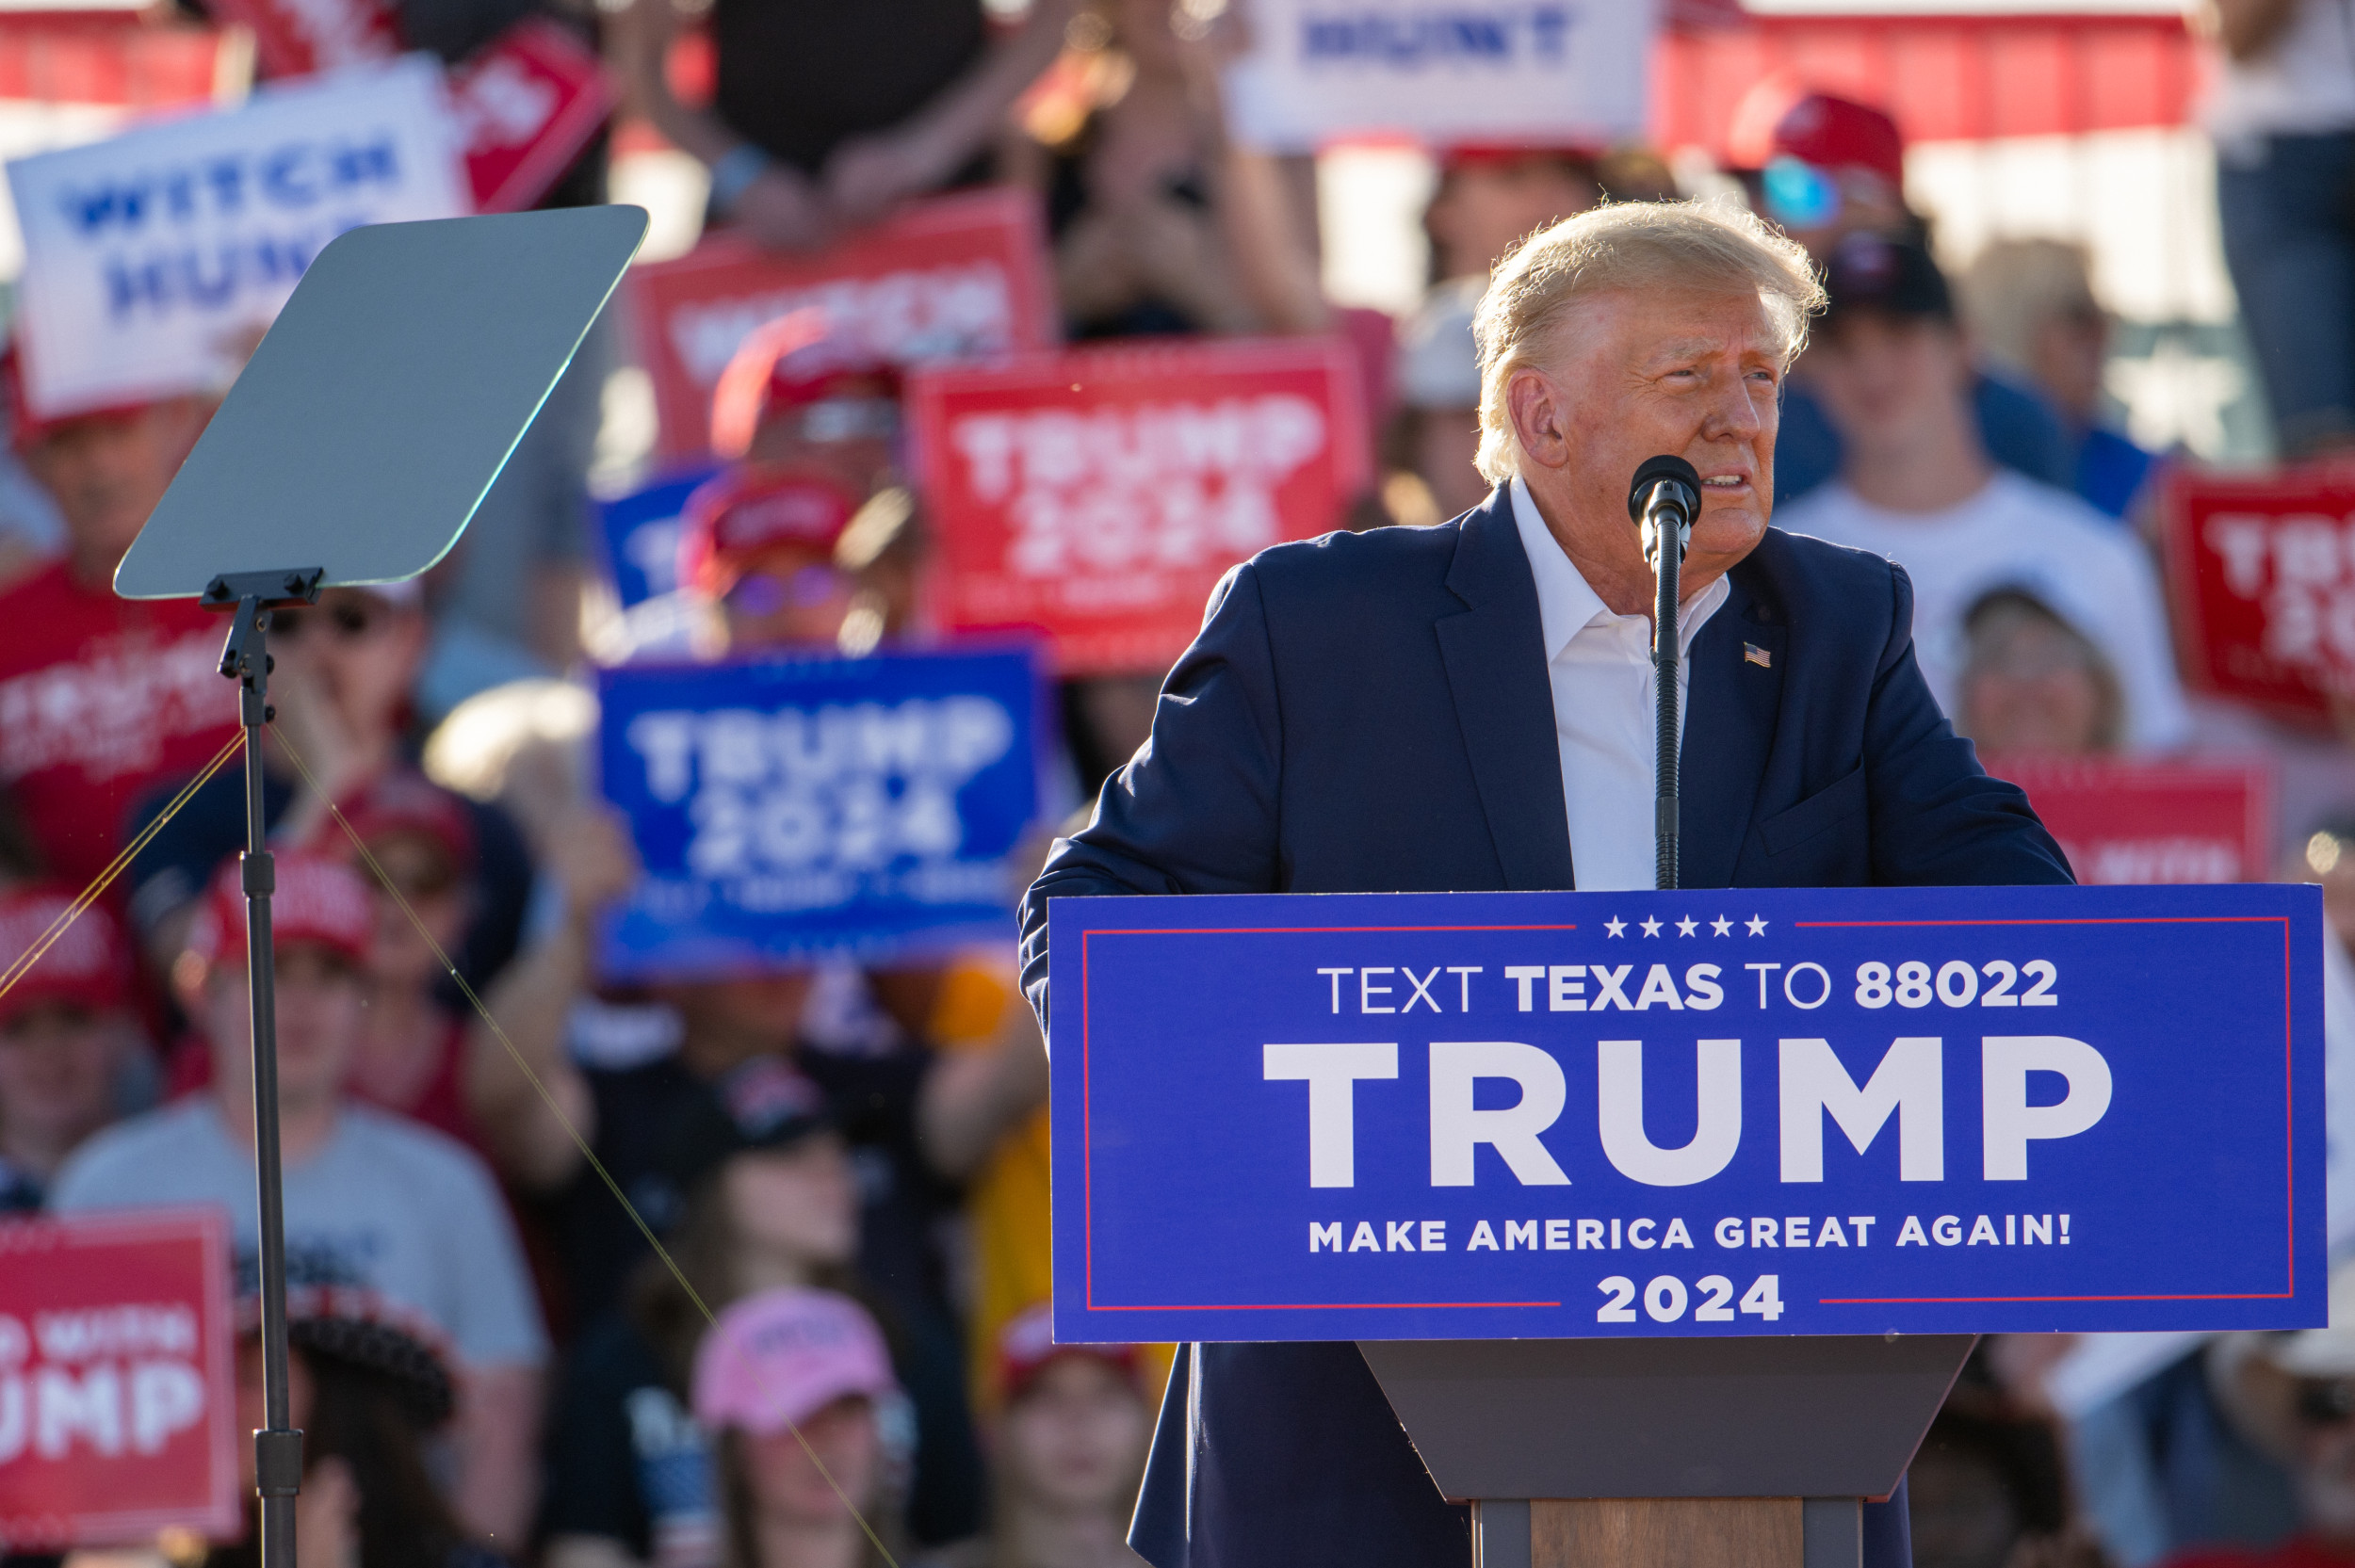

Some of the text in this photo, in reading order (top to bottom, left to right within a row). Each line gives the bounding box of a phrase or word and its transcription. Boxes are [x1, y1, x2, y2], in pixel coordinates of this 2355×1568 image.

[1296, 4, 1571, 70] HUNT
[57, 137, 400, 235] WITCH
[953, 394, 1324, 501] TRUMP
[1008, 478, 1279, 576] 2024
[626, 695, 1015, 800] TRUMP
[686, 784, 961, 878] 2024
[1317, 960, 2058, 1014] TEXT TEXAS TO 88022
[1262, 1036, 2113, 1188] TRUMP
[1309, 1215, 2071, 1253] MAKE AMERICA GREAT AGAIN!
[35, 1302, 199, 1359] WITH
[1597, 1274, 1785, 1323] 2024
